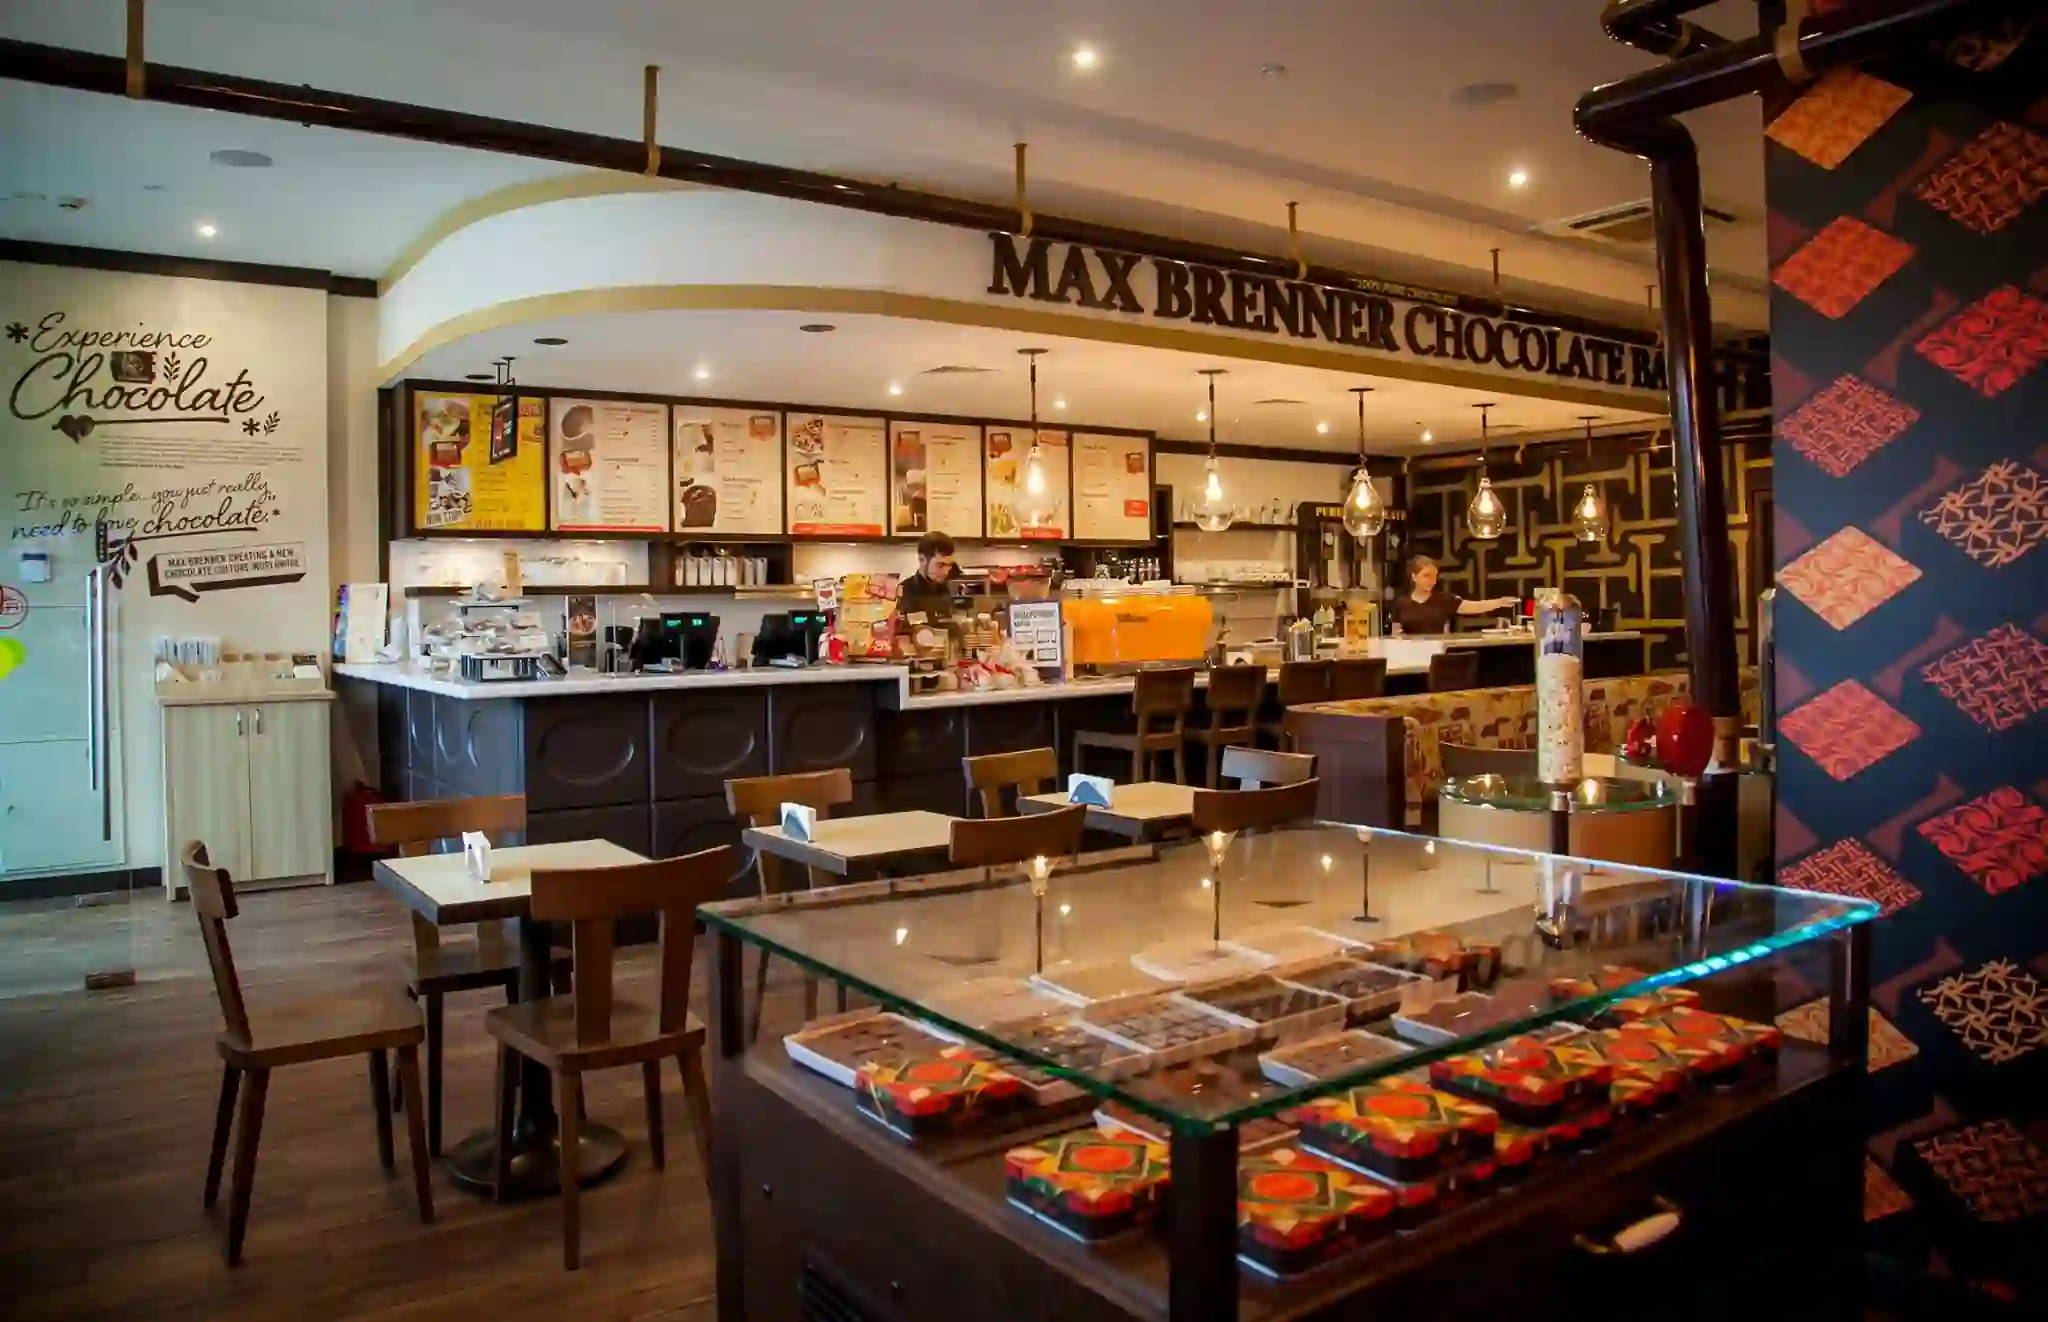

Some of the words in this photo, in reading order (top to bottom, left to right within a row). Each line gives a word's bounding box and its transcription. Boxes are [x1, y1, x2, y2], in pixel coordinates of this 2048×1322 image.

[29, 311, 212, 364] Experience
[987, 231, 1144, 314] MAX
[1153, 258, 1400, 352] BRENNER
[1404, 304, 1627, 386] CHOCOLATE
[1631, 346, 1669, 391] BA
[9, 351, 266, 420] Chocolate
[180, 478, 217, 510] just
[12, 510, 65, 540] need
